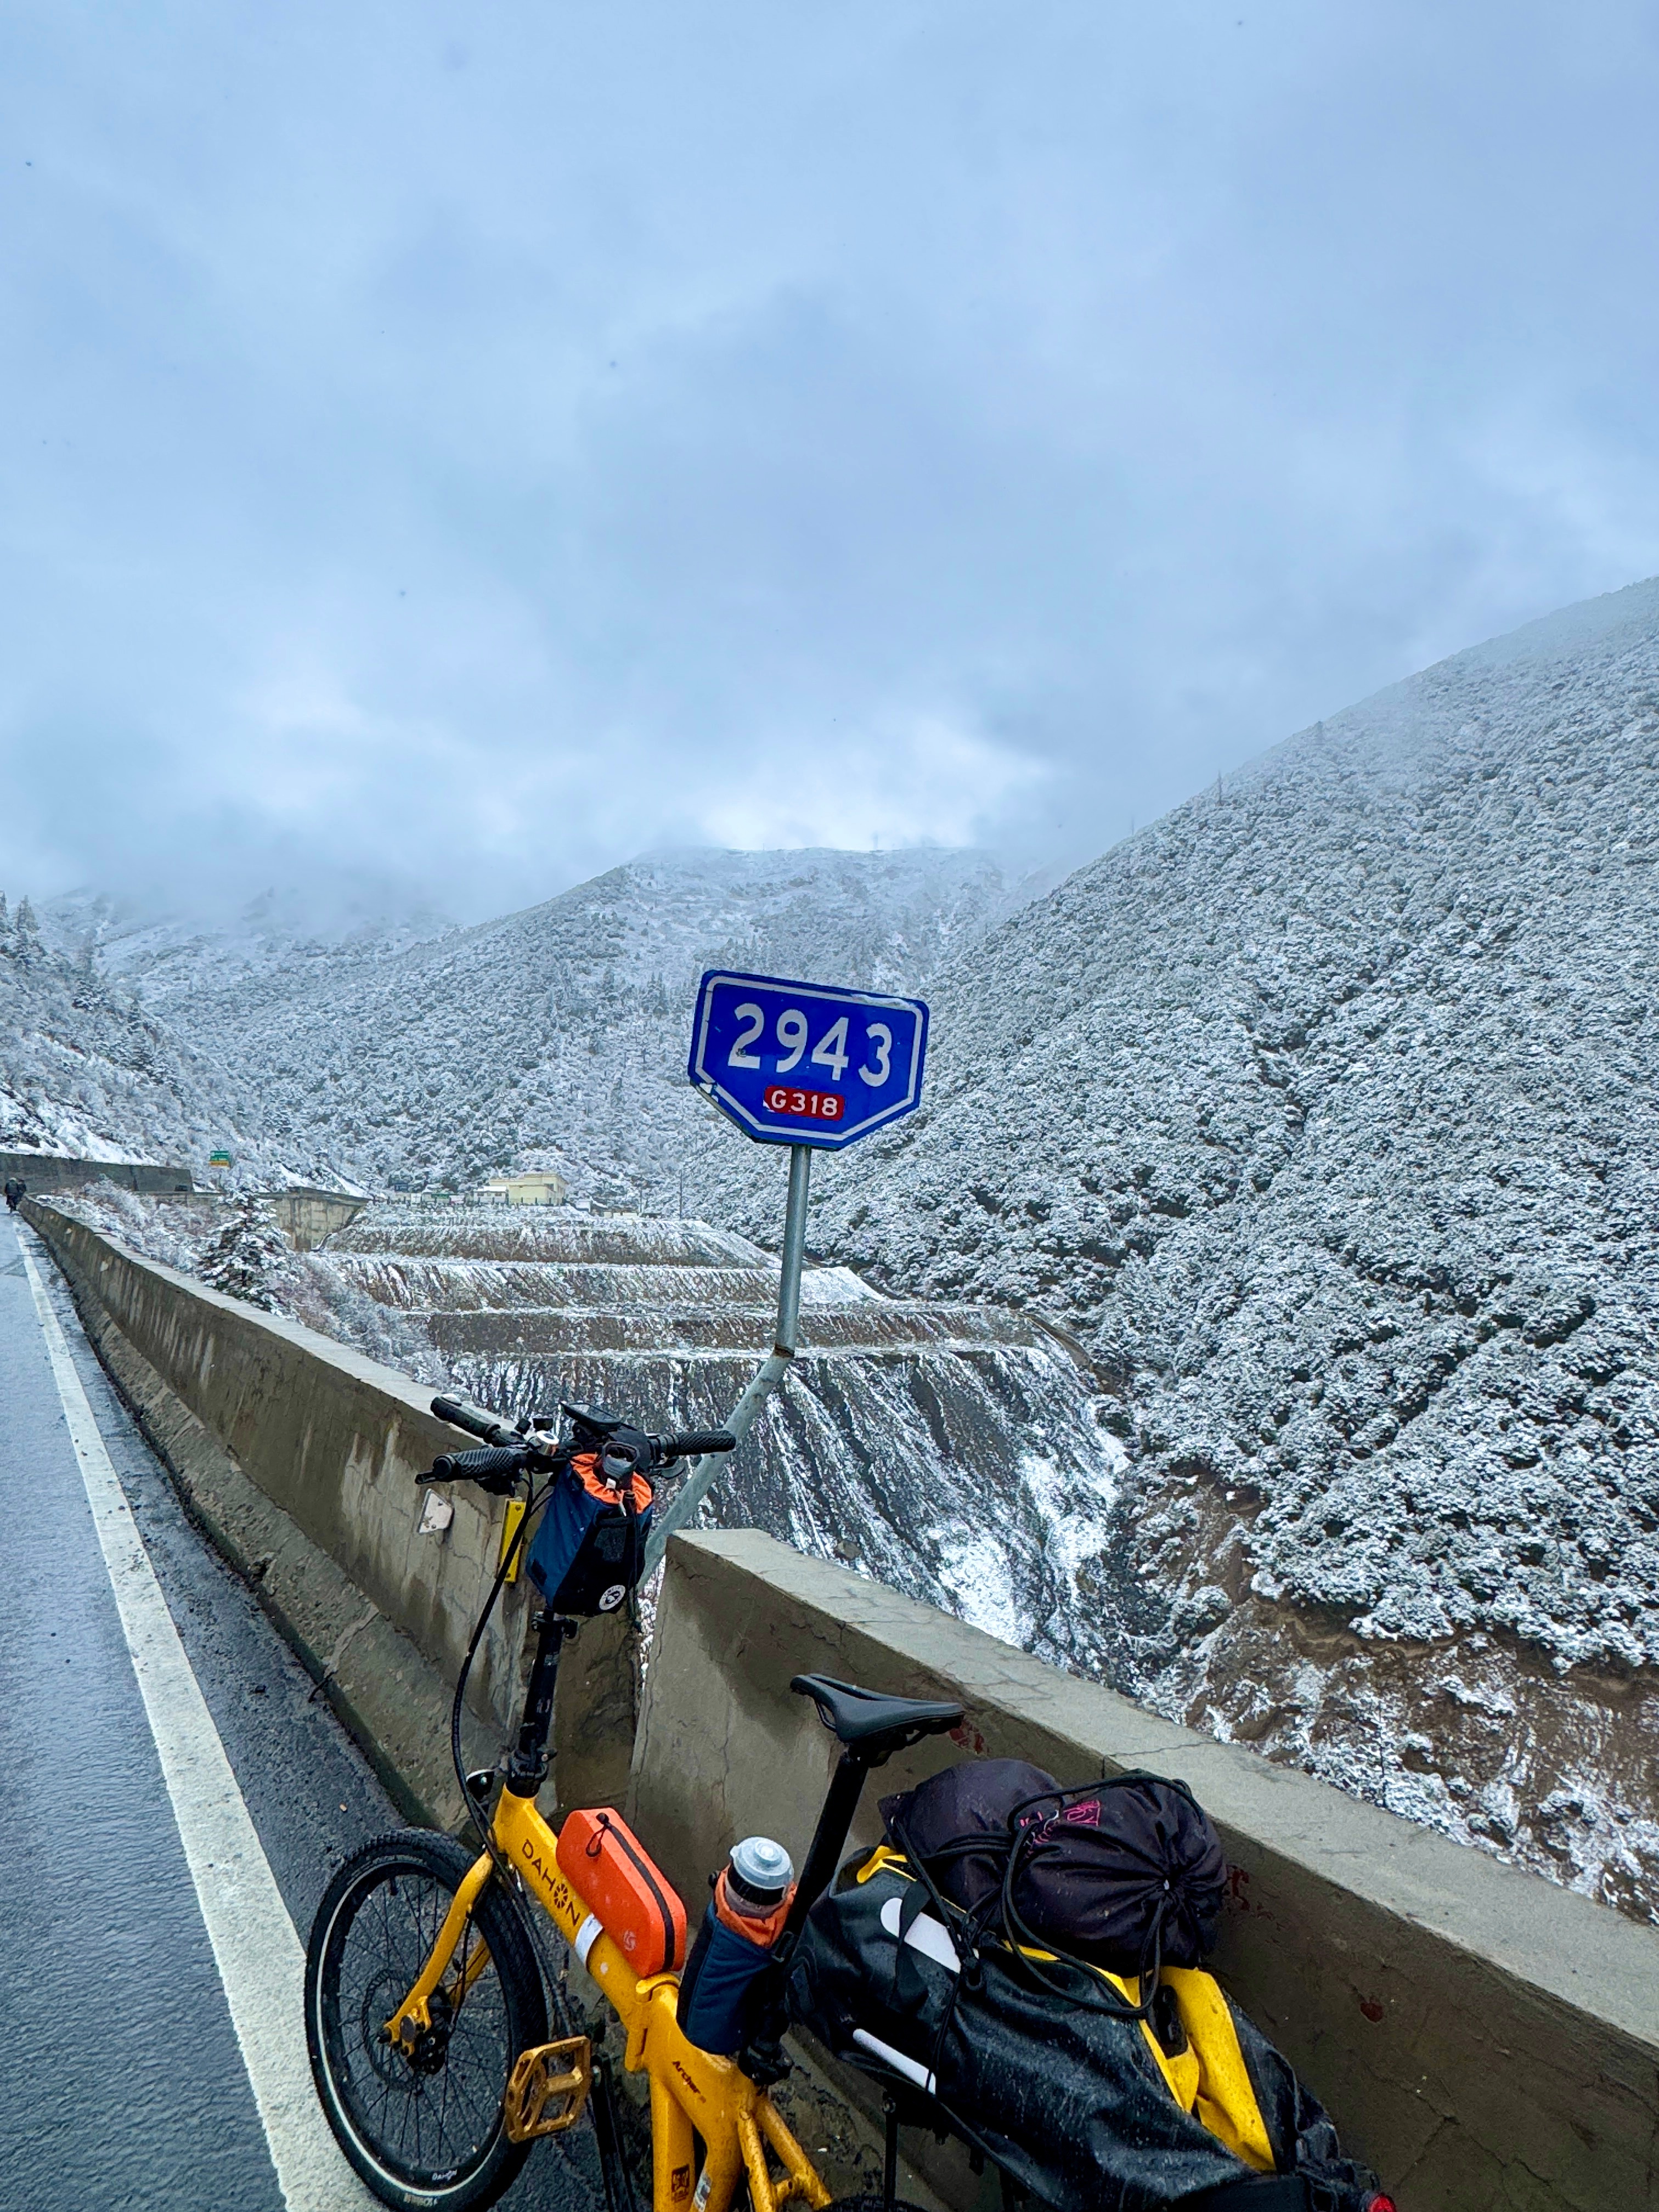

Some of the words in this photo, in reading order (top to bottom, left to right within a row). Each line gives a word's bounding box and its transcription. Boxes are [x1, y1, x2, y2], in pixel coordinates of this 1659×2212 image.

[727, 1002, 893, 1087] 2943
[771, 1090, 838, 1116] G318
[522, 1838, 580, 1926] DAHON
[672, 2061, 701, 2095] Archer
